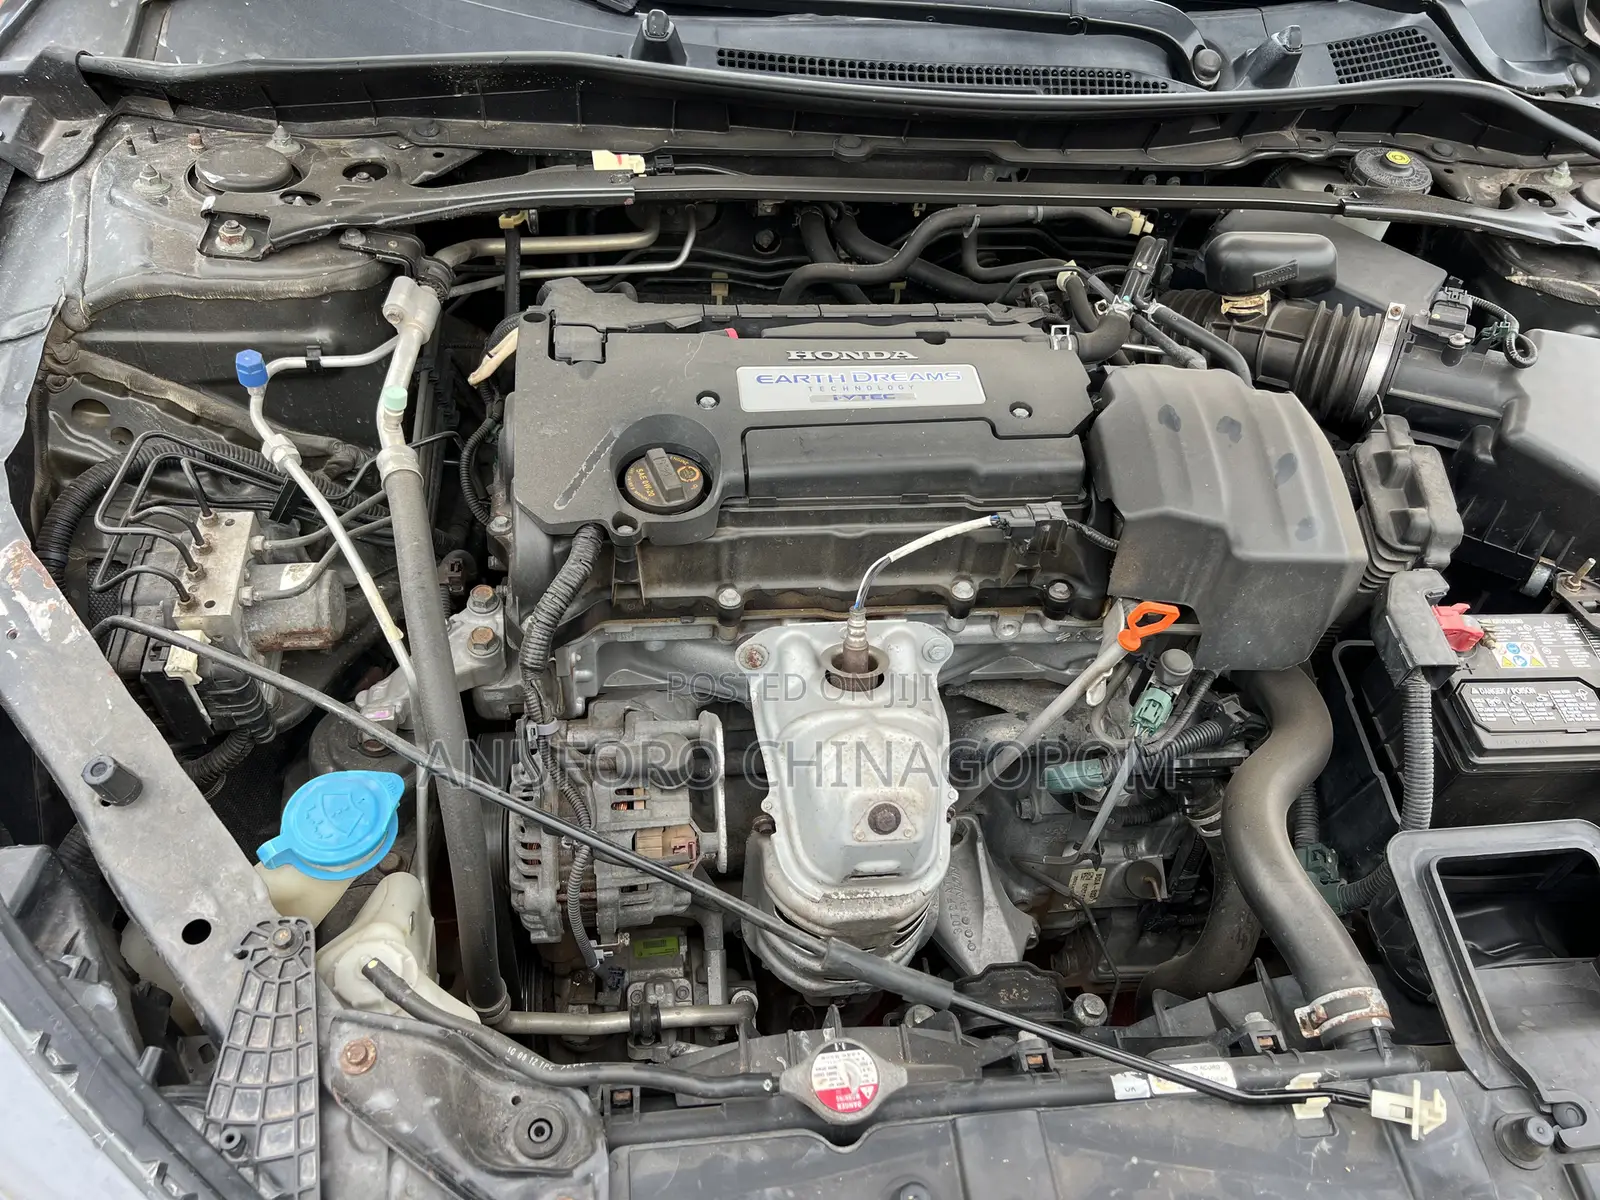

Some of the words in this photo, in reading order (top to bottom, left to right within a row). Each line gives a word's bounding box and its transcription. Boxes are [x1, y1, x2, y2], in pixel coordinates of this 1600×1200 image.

[786, 350, 918, 361] HONDA
[756, 373, 845, 384] EARTH
[852, 371, 962, 383] DREAMS
[808, 384, 915, 392] TECHNOLOGY
[636, 468, 648, 480] SAE
[642, 480, 656, 497] 0W-20
[1479, 687, 1506, 695] DANGER
[1511, 686, 1537, 695] POISON
[507, 1046, 517, 1056] 10
[528, 1056, 539, 1066] 12
[837, 1101, 862, 1110] DANGER
